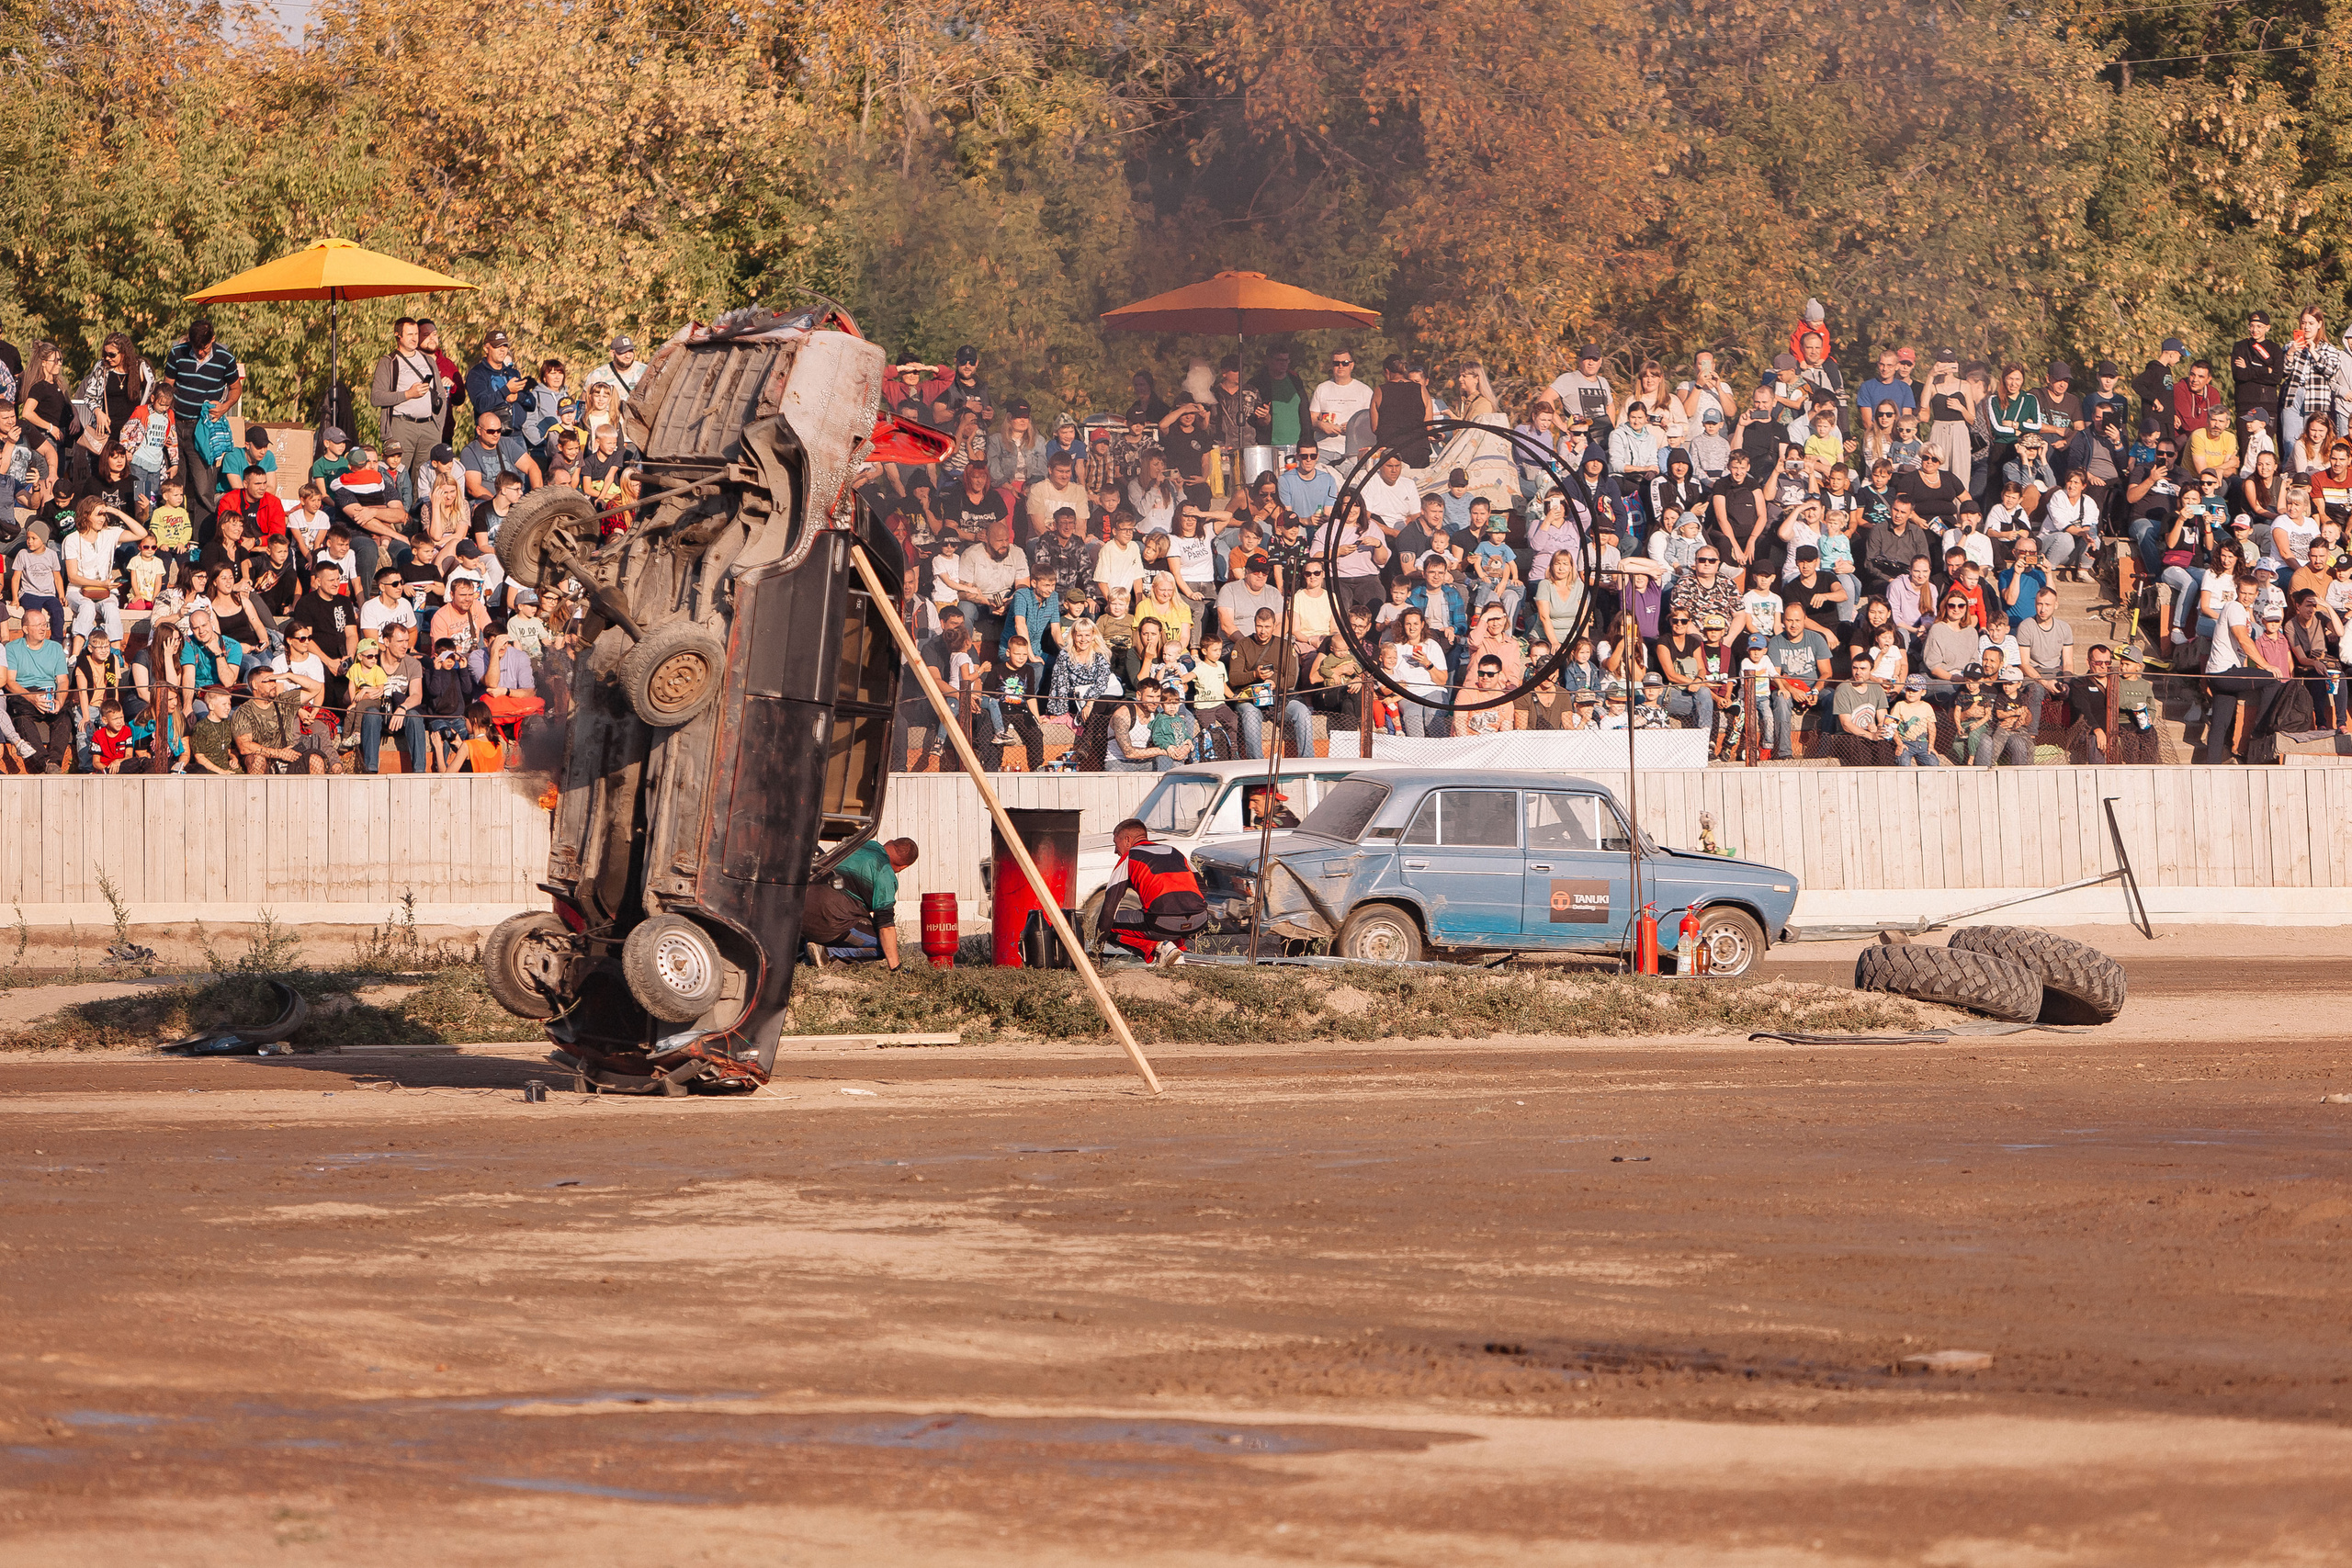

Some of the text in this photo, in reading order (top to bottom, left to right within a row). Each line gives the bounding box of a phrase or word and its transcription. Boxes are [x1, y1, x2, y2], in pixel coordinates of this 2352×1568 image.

[1187, 547, 1209, 560] PARIS
[1573, 894, 1609, 904] TANUKI
[926, 922, 958, 932] РОПАН
